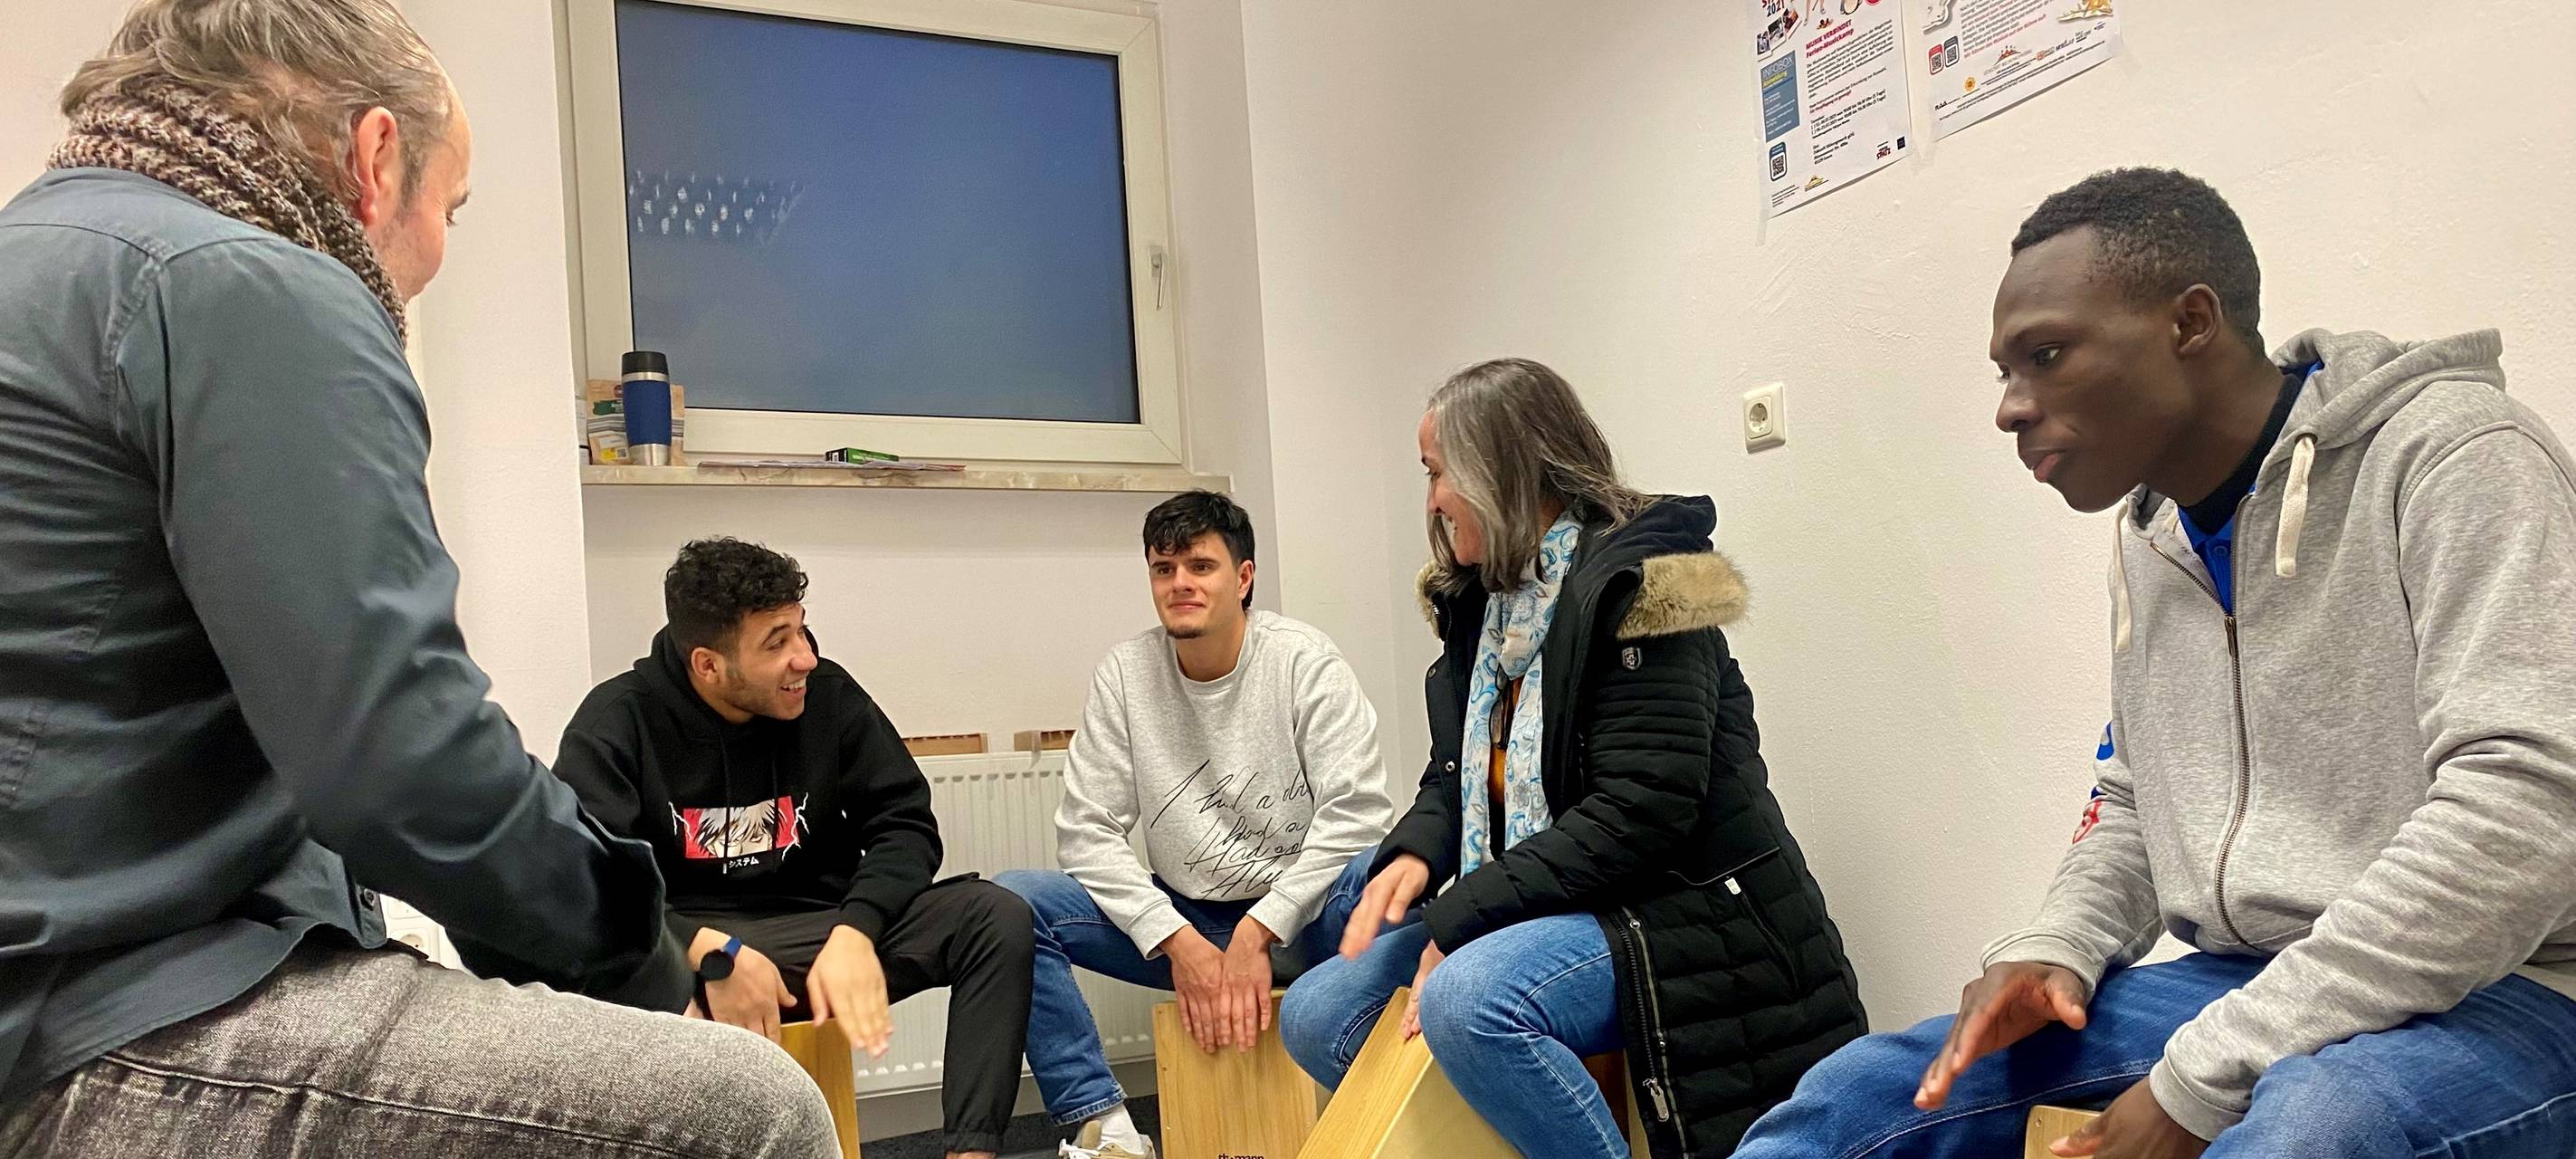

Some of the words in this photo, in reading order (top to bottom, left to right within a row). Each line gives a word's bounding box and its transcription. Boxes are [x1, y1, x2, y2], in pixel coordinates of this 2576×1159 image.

[1767, 0, 1784, 17] 2021
[729, 856, 759, 868] システム
